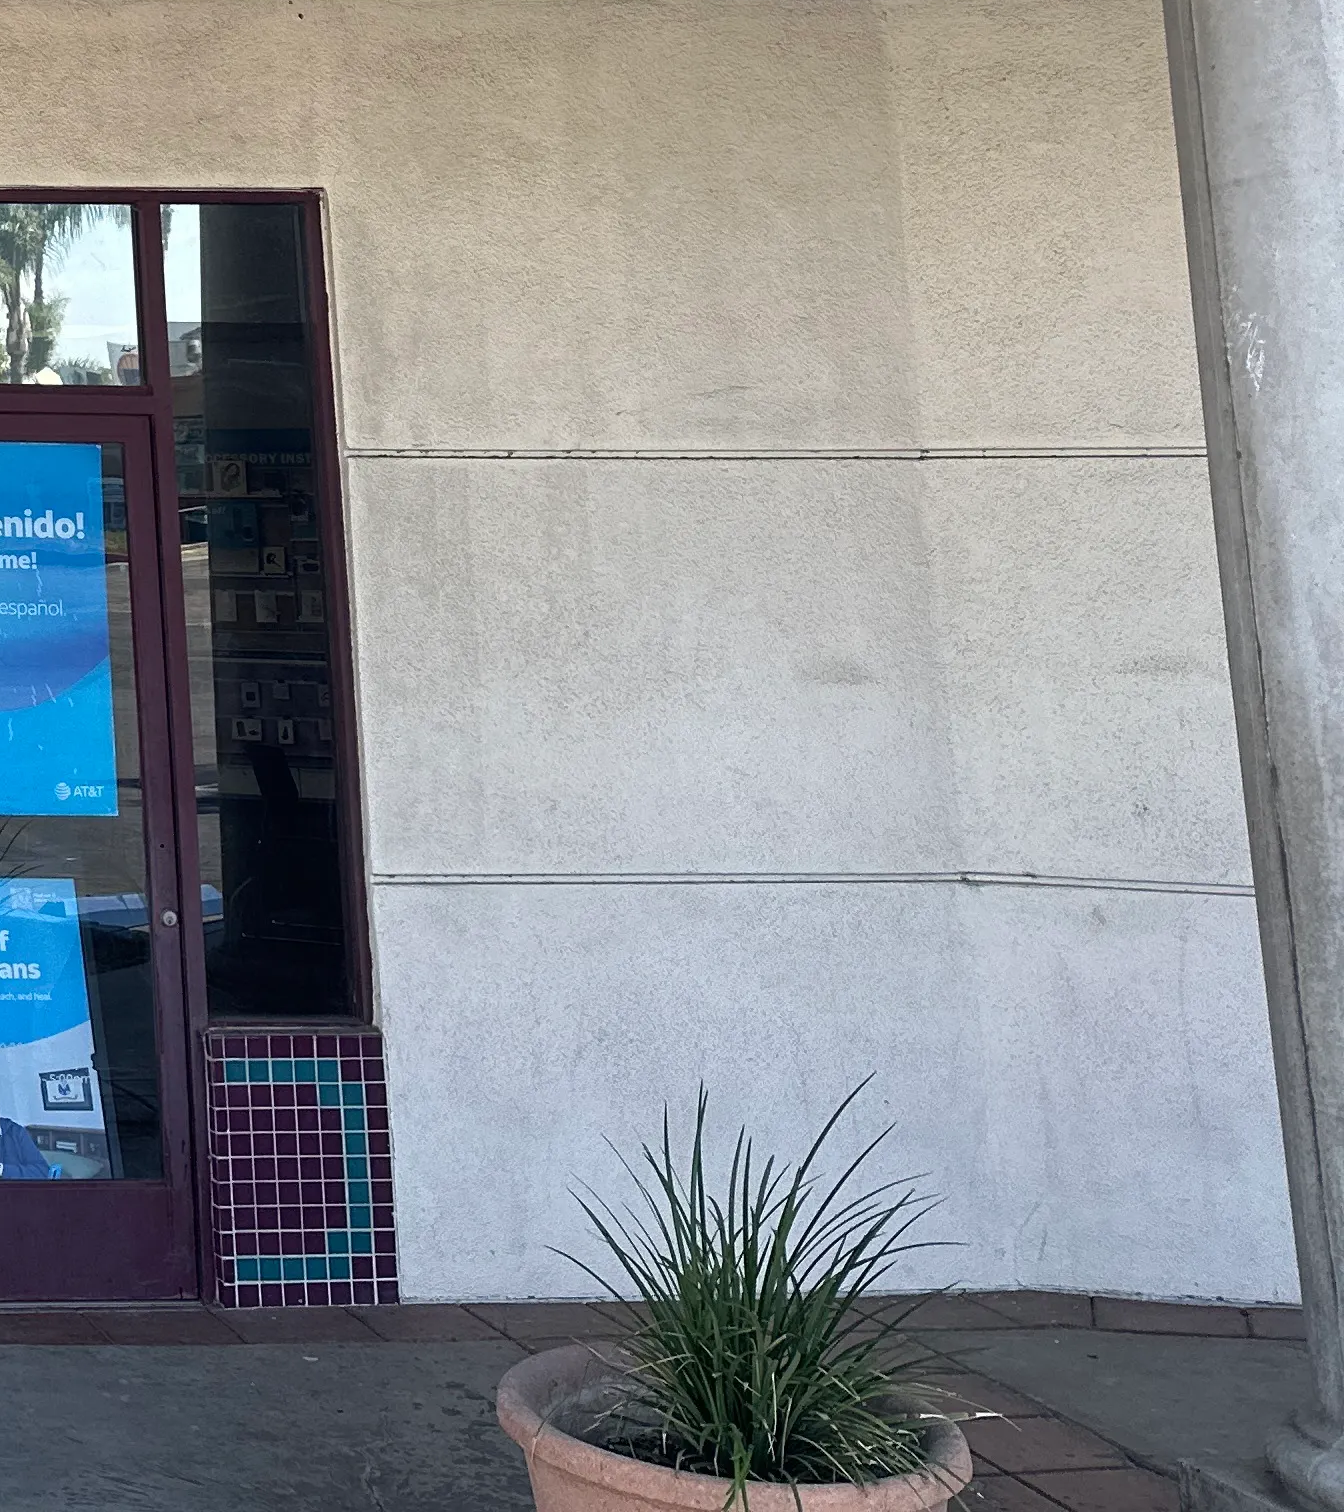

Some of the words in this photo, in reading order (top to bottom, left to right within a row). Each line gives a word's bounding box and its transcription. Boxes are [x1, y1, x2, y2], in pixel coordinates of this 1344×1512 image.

[198, 452, 277, 464] CCESSORY
[73, 785, 105, 798] AT&T
[17, 992, 33, 1001] and
